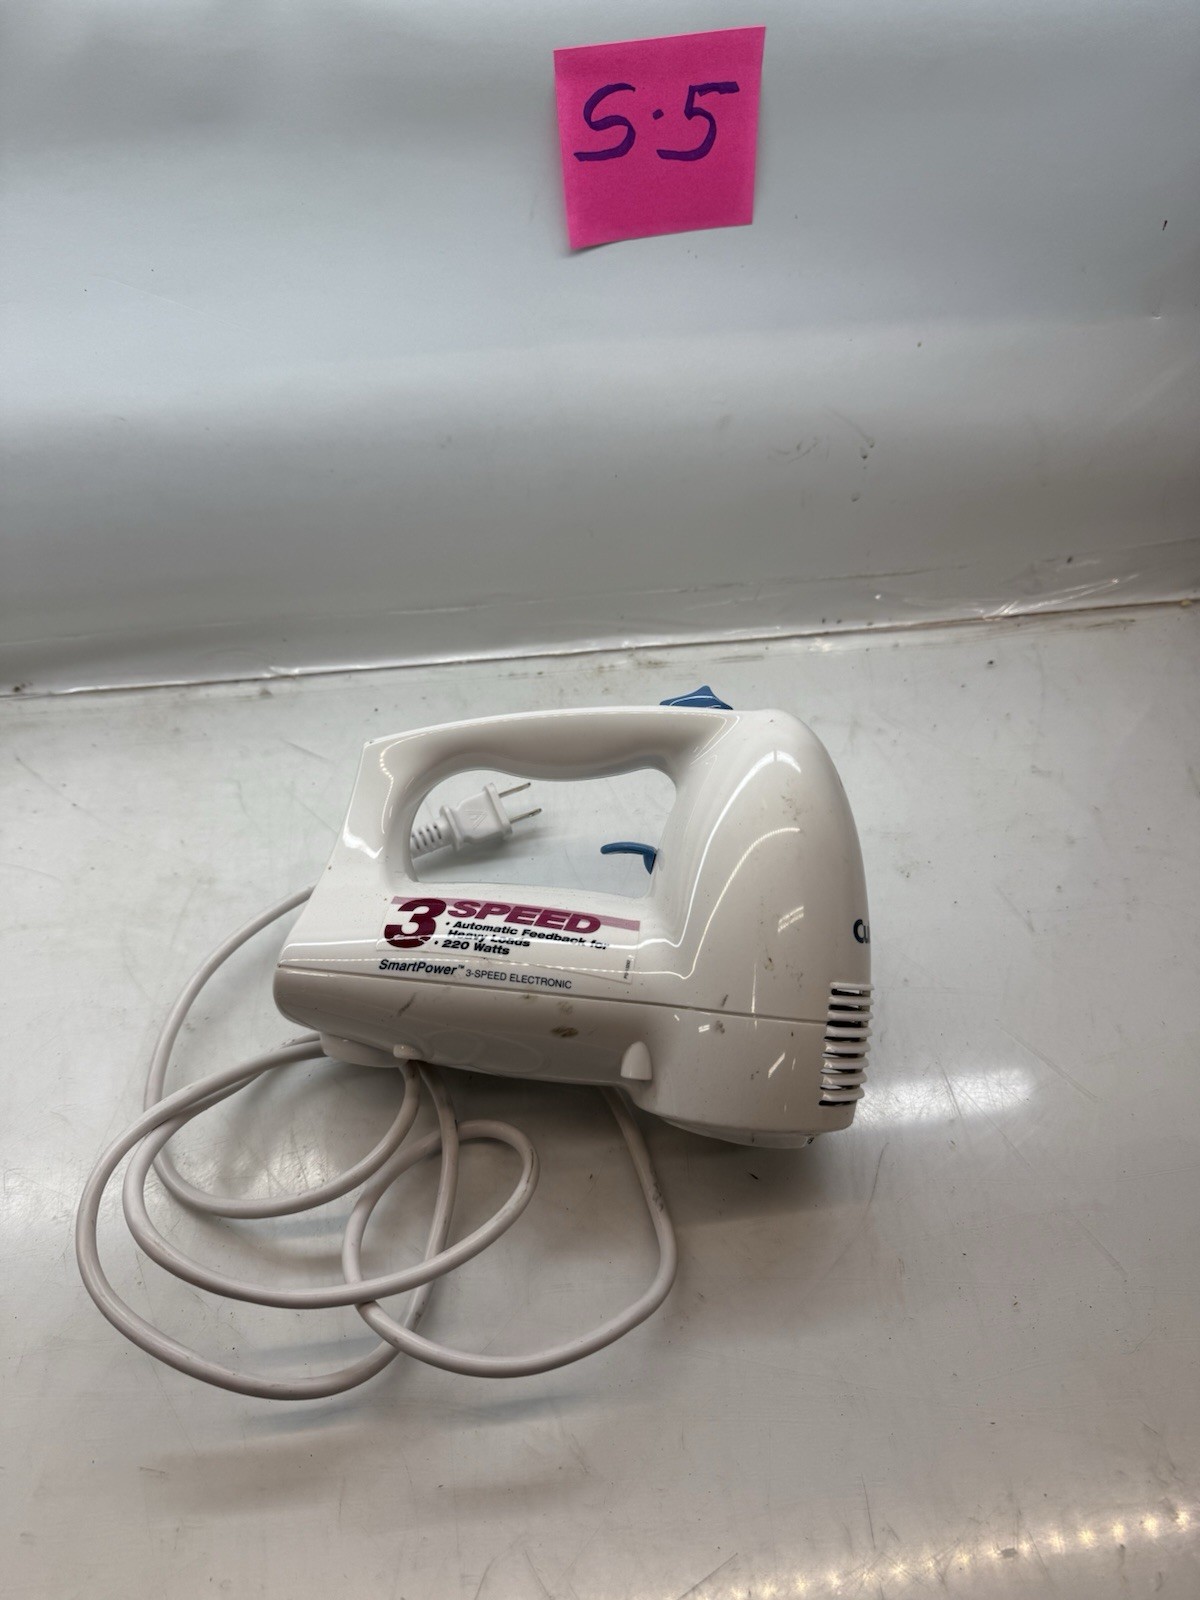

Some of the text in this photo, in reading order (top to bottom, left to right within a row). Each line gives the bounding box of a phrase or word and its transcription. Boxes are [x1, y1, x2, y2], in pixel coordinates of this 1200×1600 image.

[384, 898, 602, 949] 3 SPEED
[452, 920, 518, 935] Automatic
[521, 928, 587, 947] Feedback
[441, 939, 511, 955] 220 Watts
[465, 968, 508, 981] 3-SPEED
[509, 973, 573, 989] ELECTRONIC
